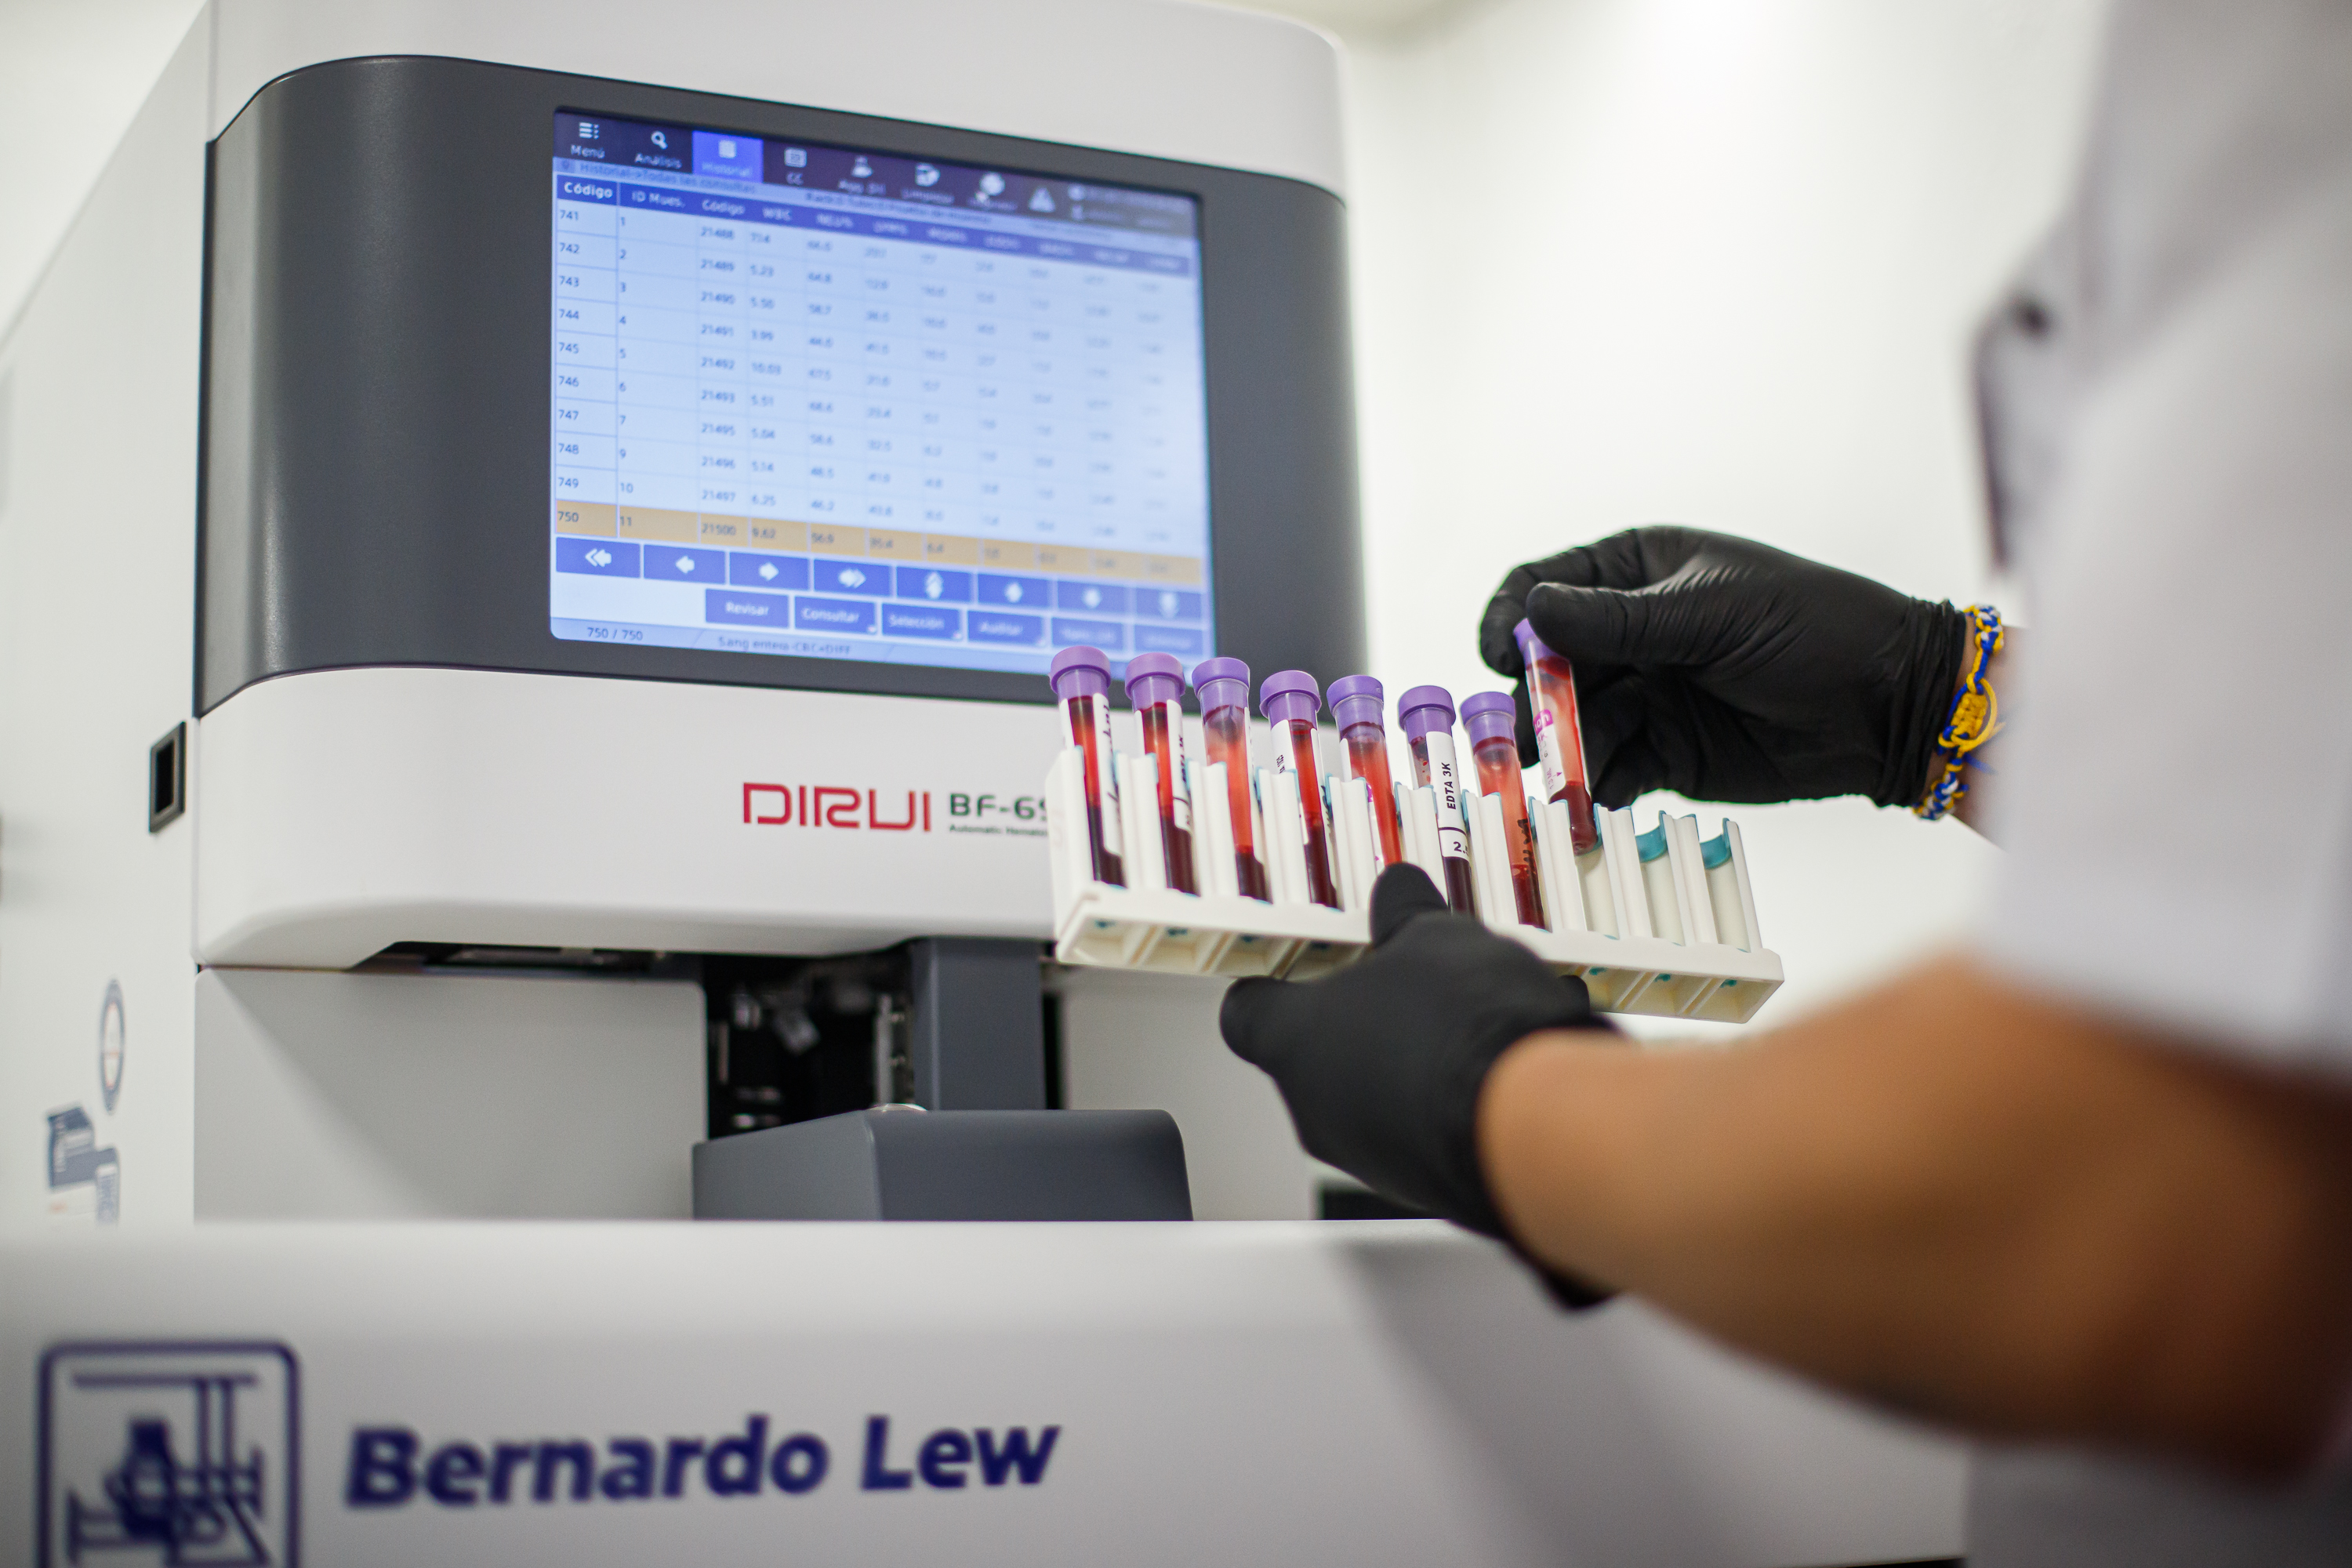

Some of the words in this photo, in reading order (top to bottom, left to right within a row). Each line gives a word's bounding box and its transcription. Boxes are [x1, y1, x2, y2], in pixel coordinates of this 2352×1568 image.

[564, 182, 613, 199] Código
[632, 191, 645, 203] ID
[559, 209, 579, 221] 741
[559, 243, 579, 254] 742
[559, 276, 579, 287] 743
[559, 309, 579, 321] 744
[558, 343, 579, 354] 745
[558, 376, 579, 387] 746
[558, 409, 579, 421] 747
[558, 443, 579, 455] 748
[558, 477, 579, 488] 749
[557, 511, 579, 523] 750
[724, 601, 769, 617] Revisar
[587, 627, 609, 640] 750
[621, 630, 643, 641] 750
[1441, 762, 1452, 777] 3K
[1444, 781, 1457, 810] EDTA
[743, 782, 931, 833] DIRUI
[342, 1414, 830, 1512] Bernardo
[858, 1414, 1062, 1494] Lew
